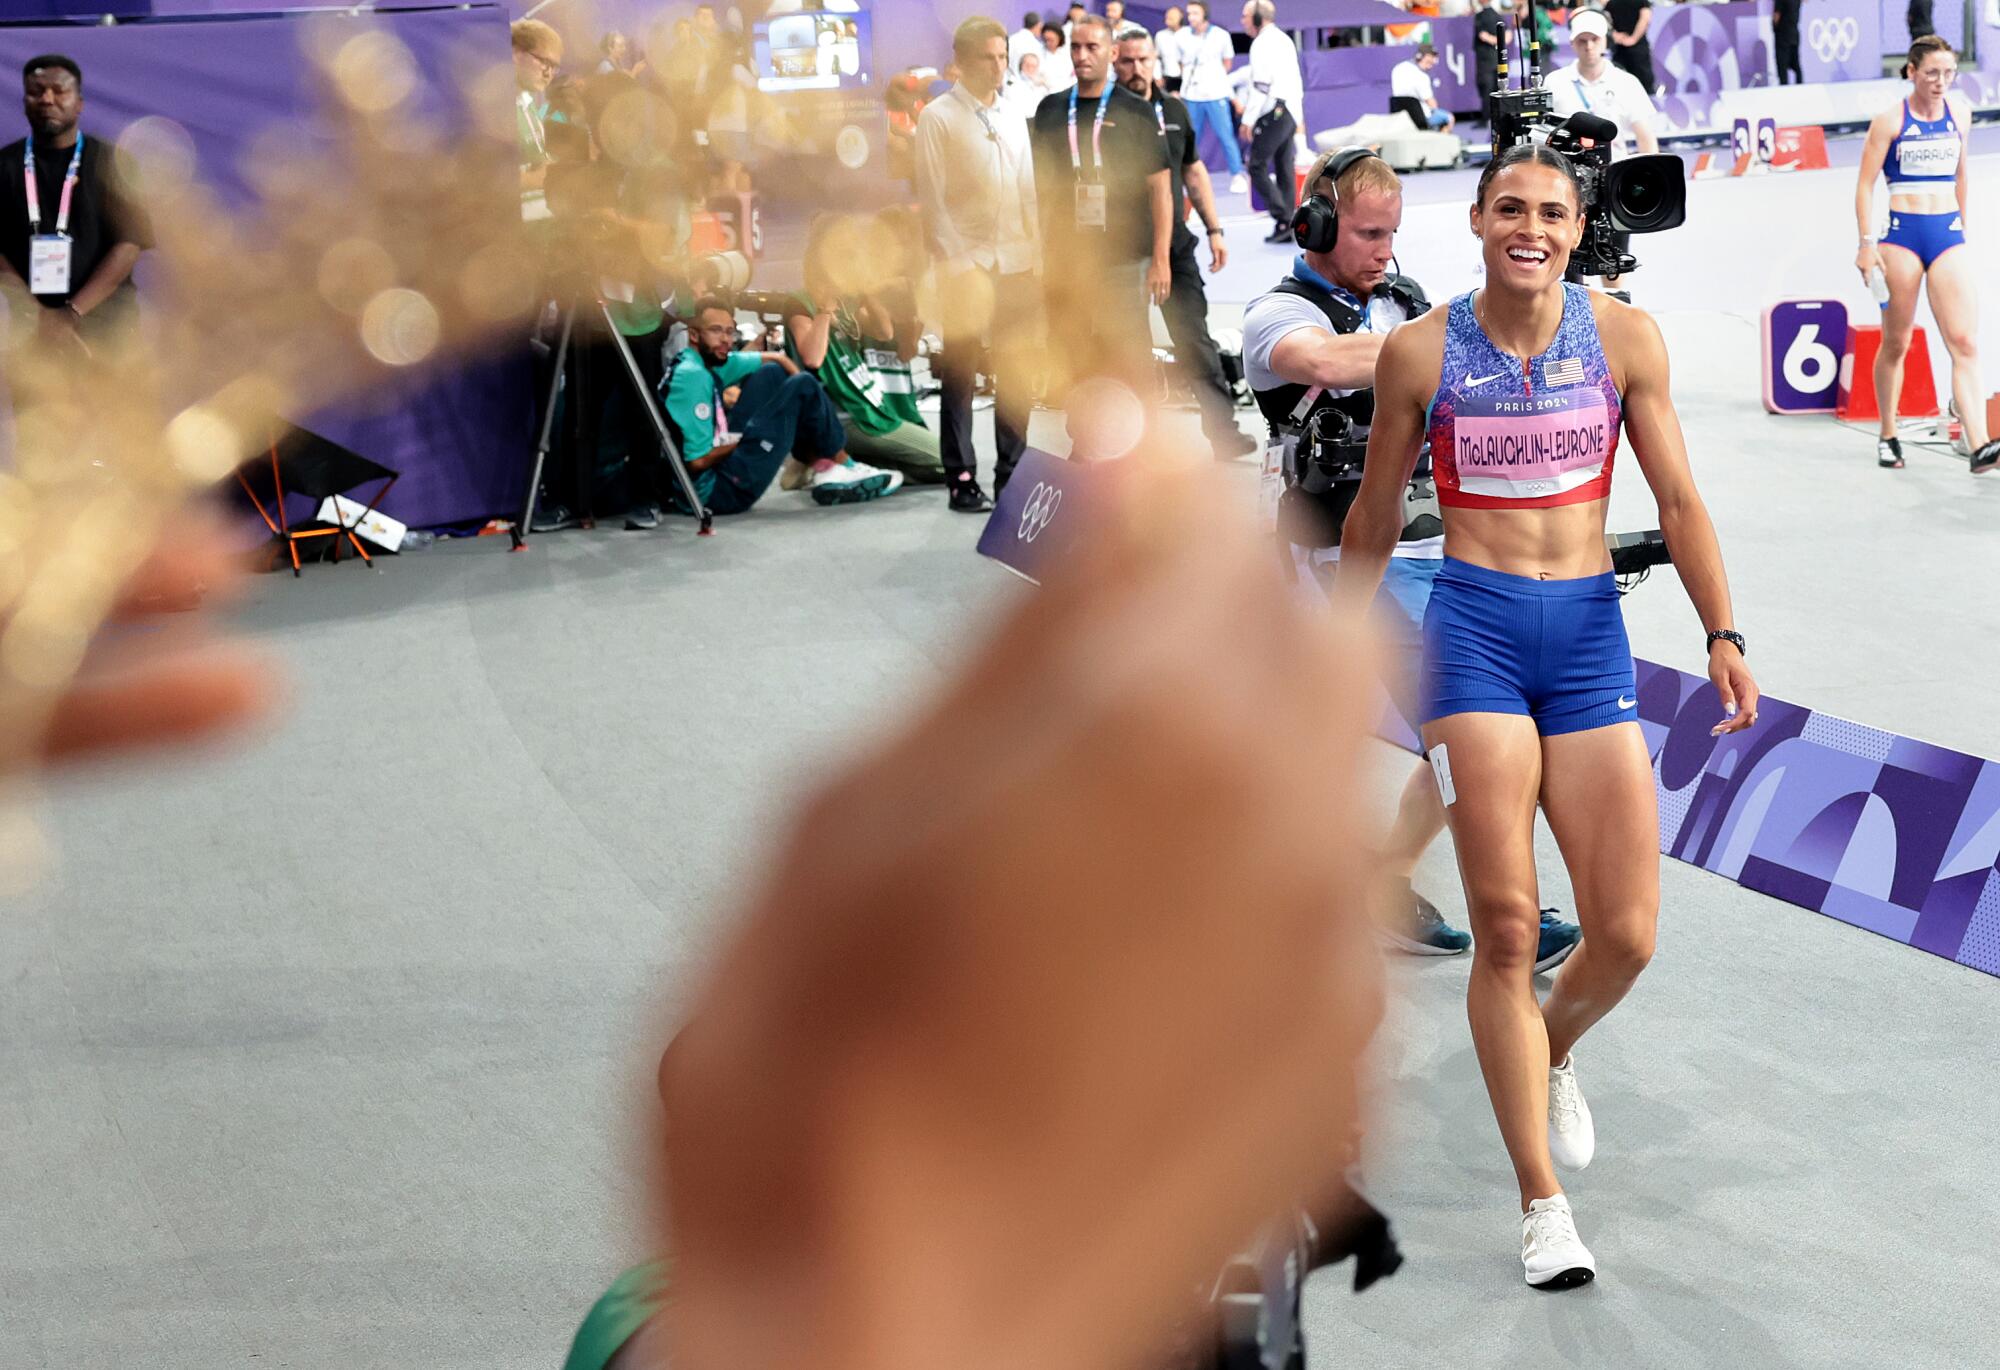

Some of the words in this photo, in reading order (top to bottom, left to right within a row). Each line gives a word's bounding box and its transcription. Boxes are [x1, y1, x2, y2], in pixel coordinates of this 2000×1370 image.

[1758, 126, 1775, 161] 3
[1783, 324, 1838, 393] 6
[1495, 402, 1533, 412] PARIS
[1537, 398, 1568, 411] 2024
[1460, 424, 1604, 466] McLAUGHLIN-LEVRONE
